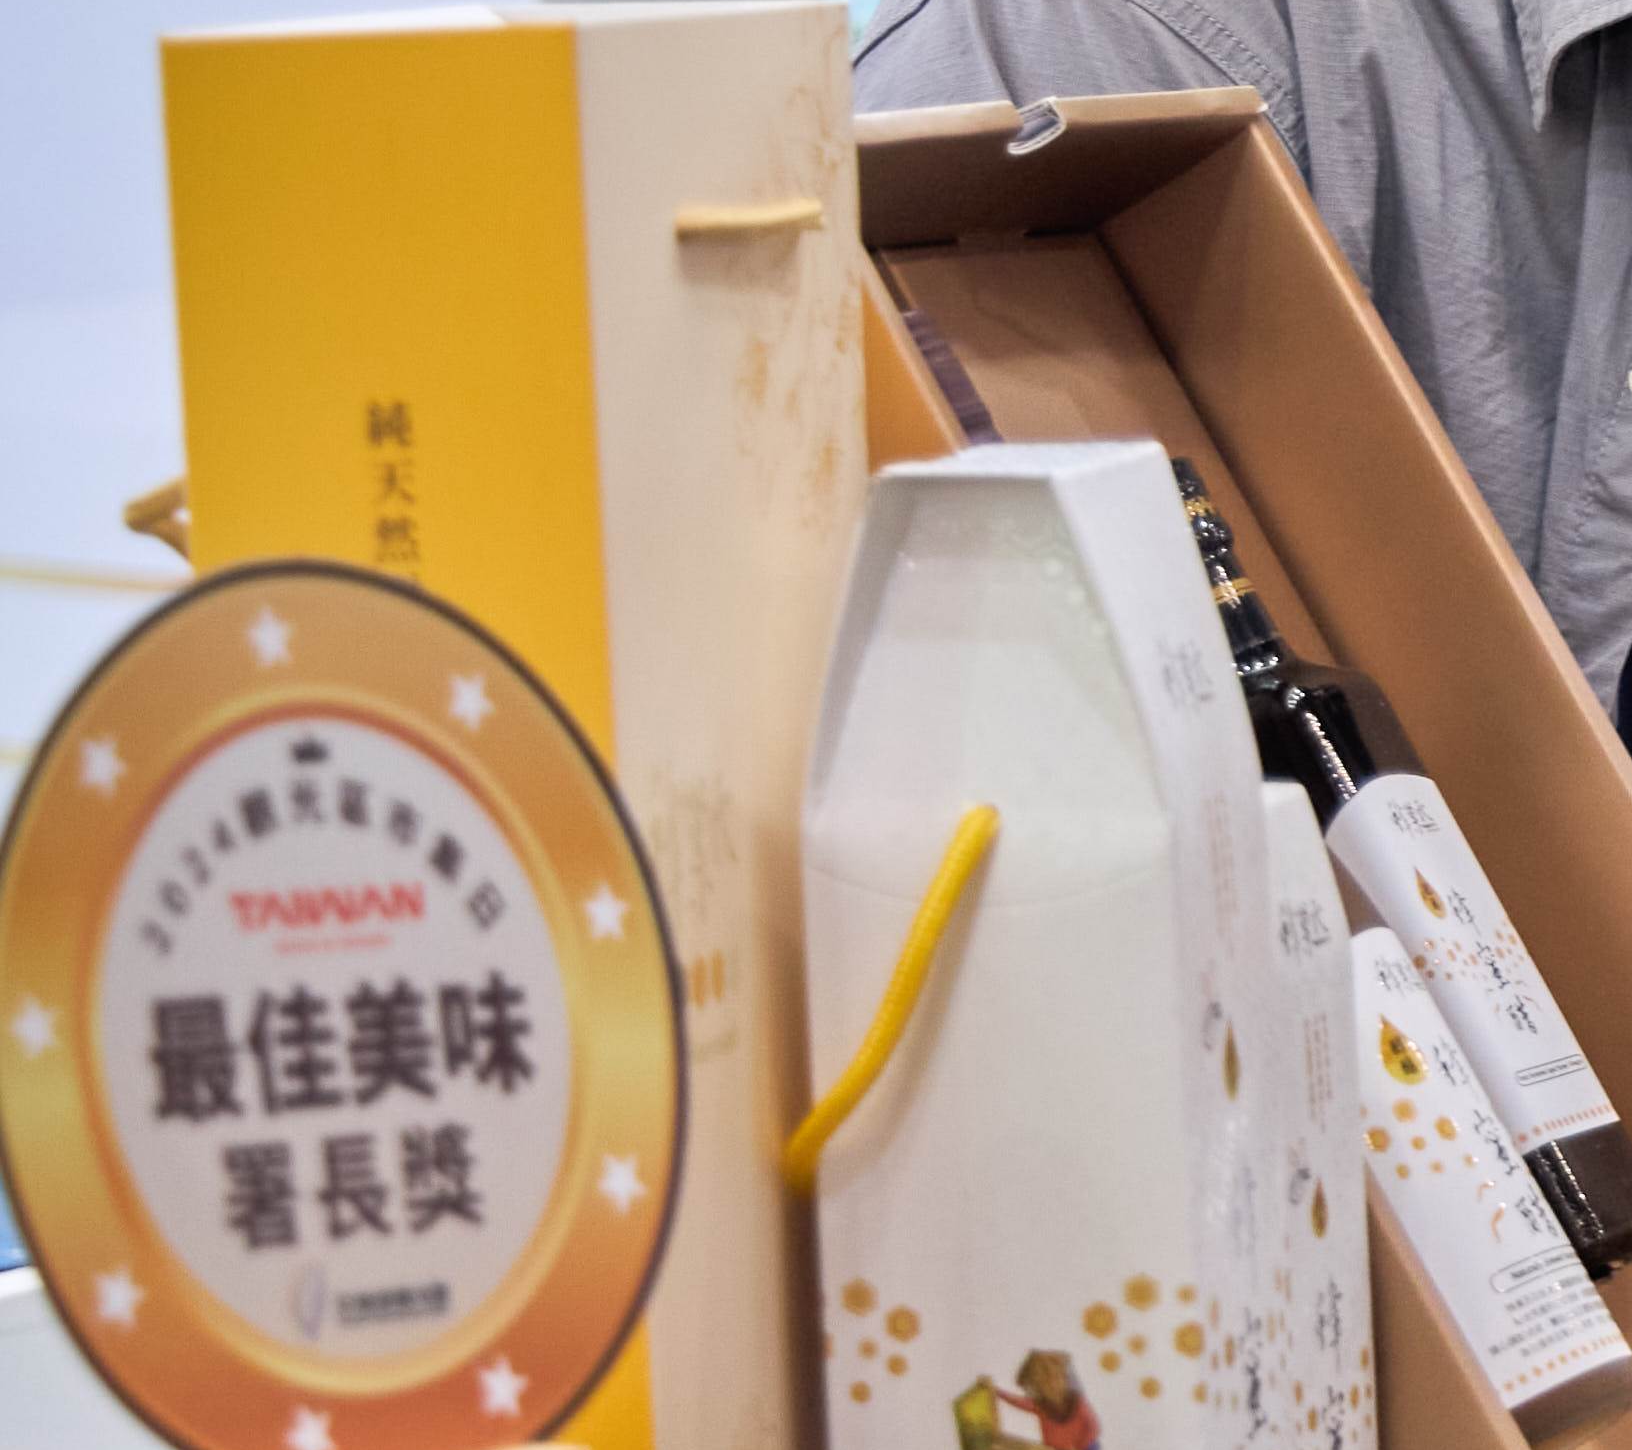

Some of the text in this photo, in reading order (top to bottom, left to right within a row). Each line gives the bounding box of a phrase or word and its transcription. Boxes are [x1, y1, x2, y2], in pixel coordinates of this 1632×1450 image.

[365, 397, 422, 584] 純天然
[228, 880, 428, 935] TAIWAN
[149, 971, 537, 1126] 最佳美味
[220, 1123, 486, 1256] 署長獎
